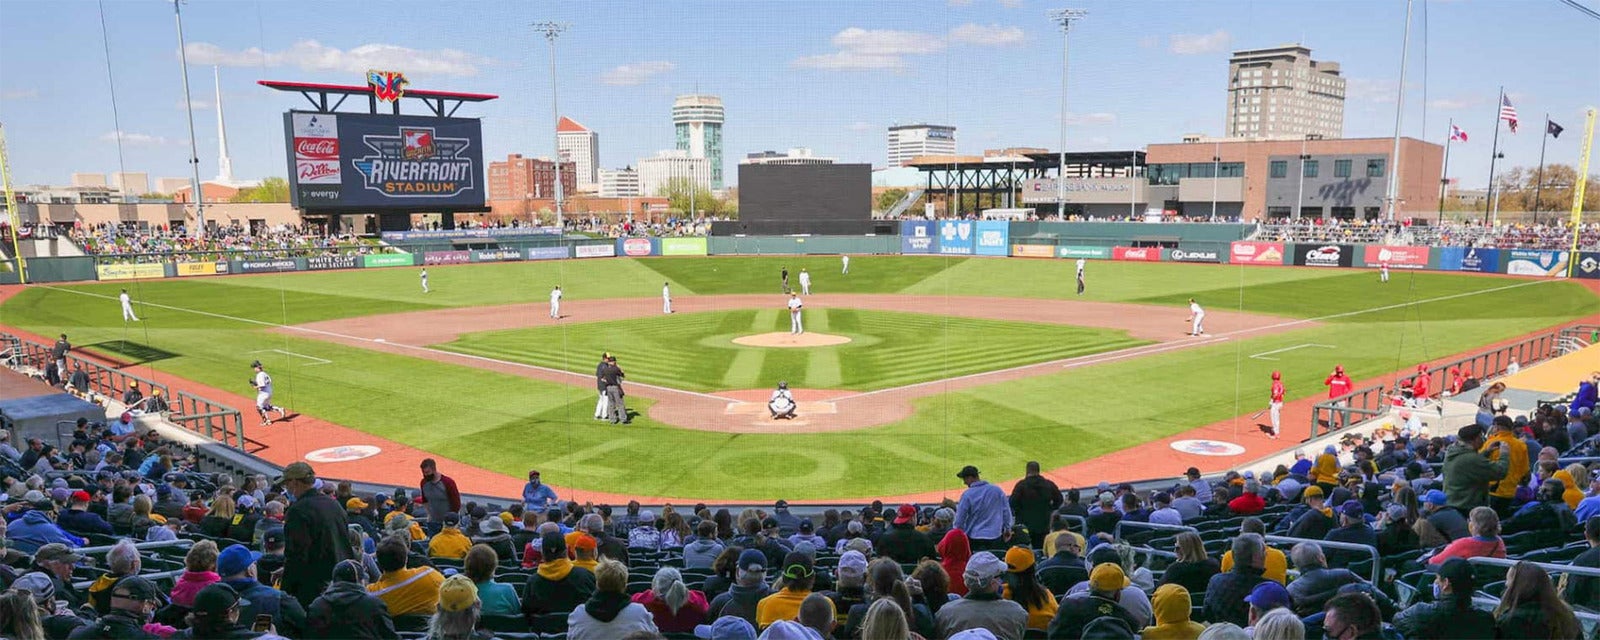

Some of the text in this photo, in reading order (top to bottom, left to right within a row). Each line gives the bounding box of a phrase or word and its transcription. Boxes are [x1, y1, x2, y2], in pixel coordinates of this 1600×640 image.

[298, 140, 335, 154] Coca-Cola
[370, 160, 469, 184] RIVERFRONT
[384, 182, 455, 192] STADIUM
[310, 191, 340, 199] evergy
[1183, 252, 1217, 260] LEXUS
